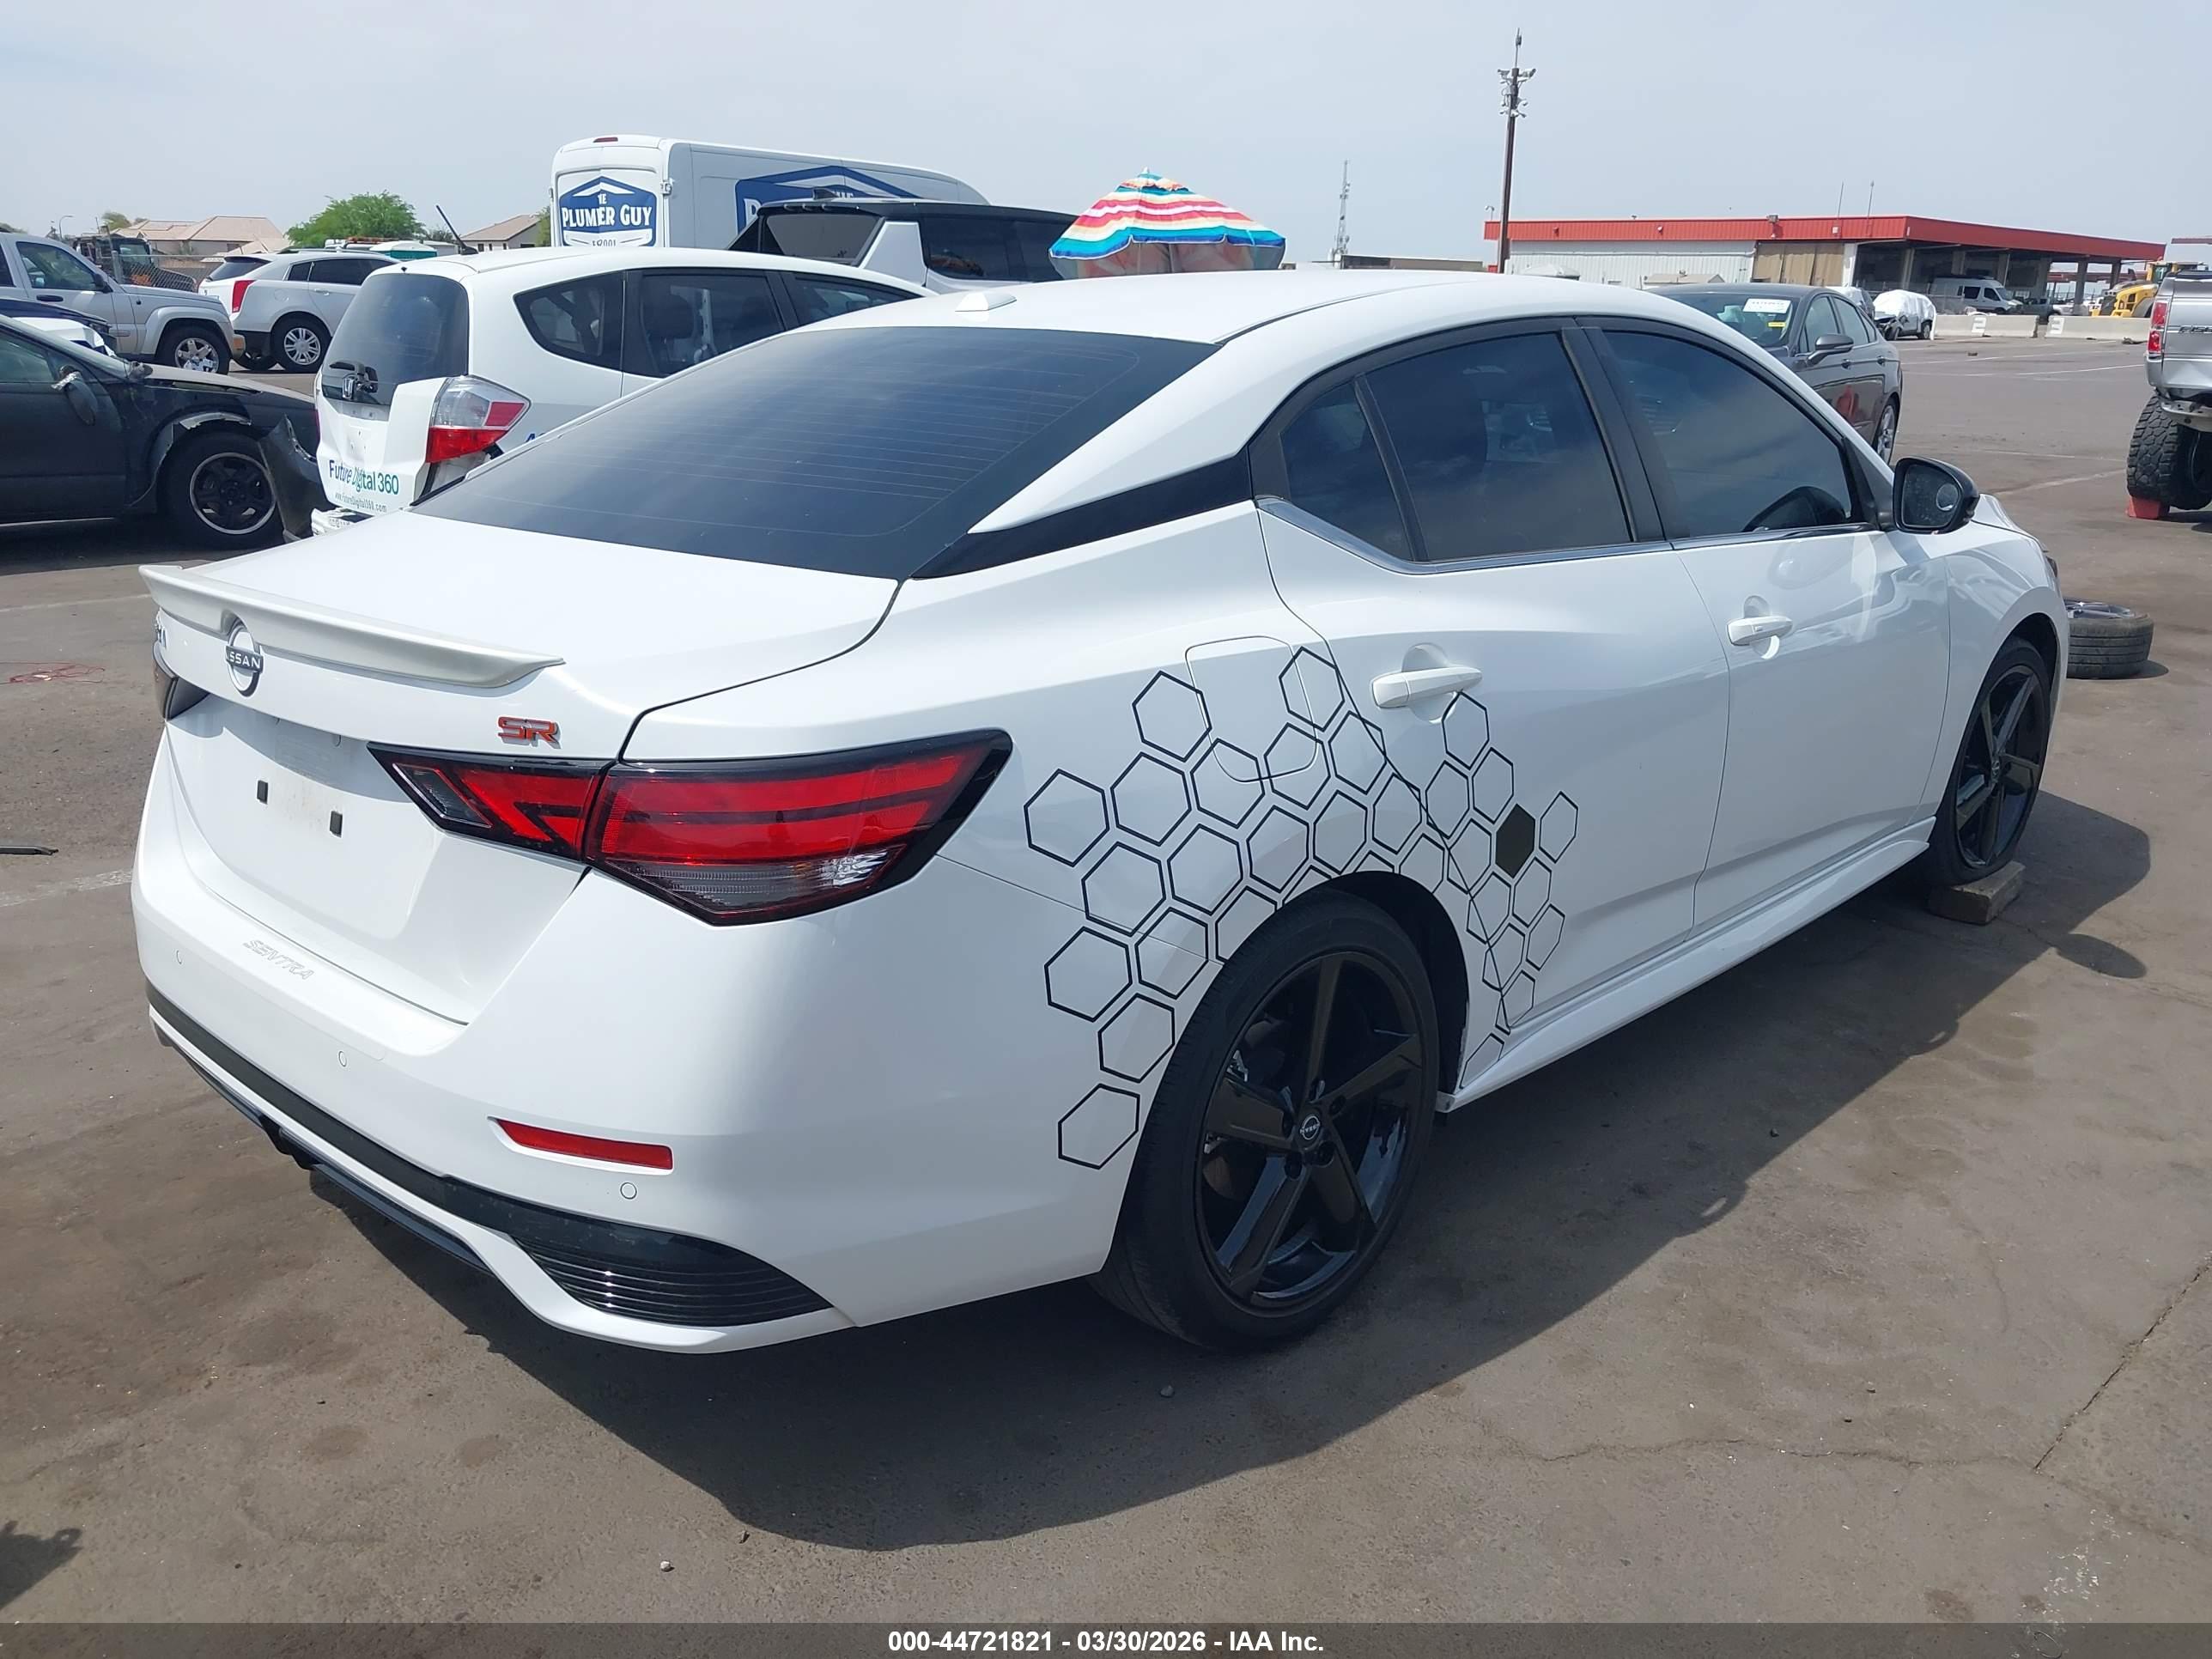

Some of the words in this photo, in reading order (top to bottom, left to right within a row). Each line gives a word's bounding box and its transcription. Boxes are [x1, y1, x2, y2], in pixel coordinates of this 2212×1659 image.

[619, 204, 653, 227] GUY
[1971, 317, 1987, 334] 2
[329, 459, 353, 484] Future
[377, 471, 399, 495] 360
[497, 715, 558, 744] SR
[242, 939, 314, 981] SENTRA
